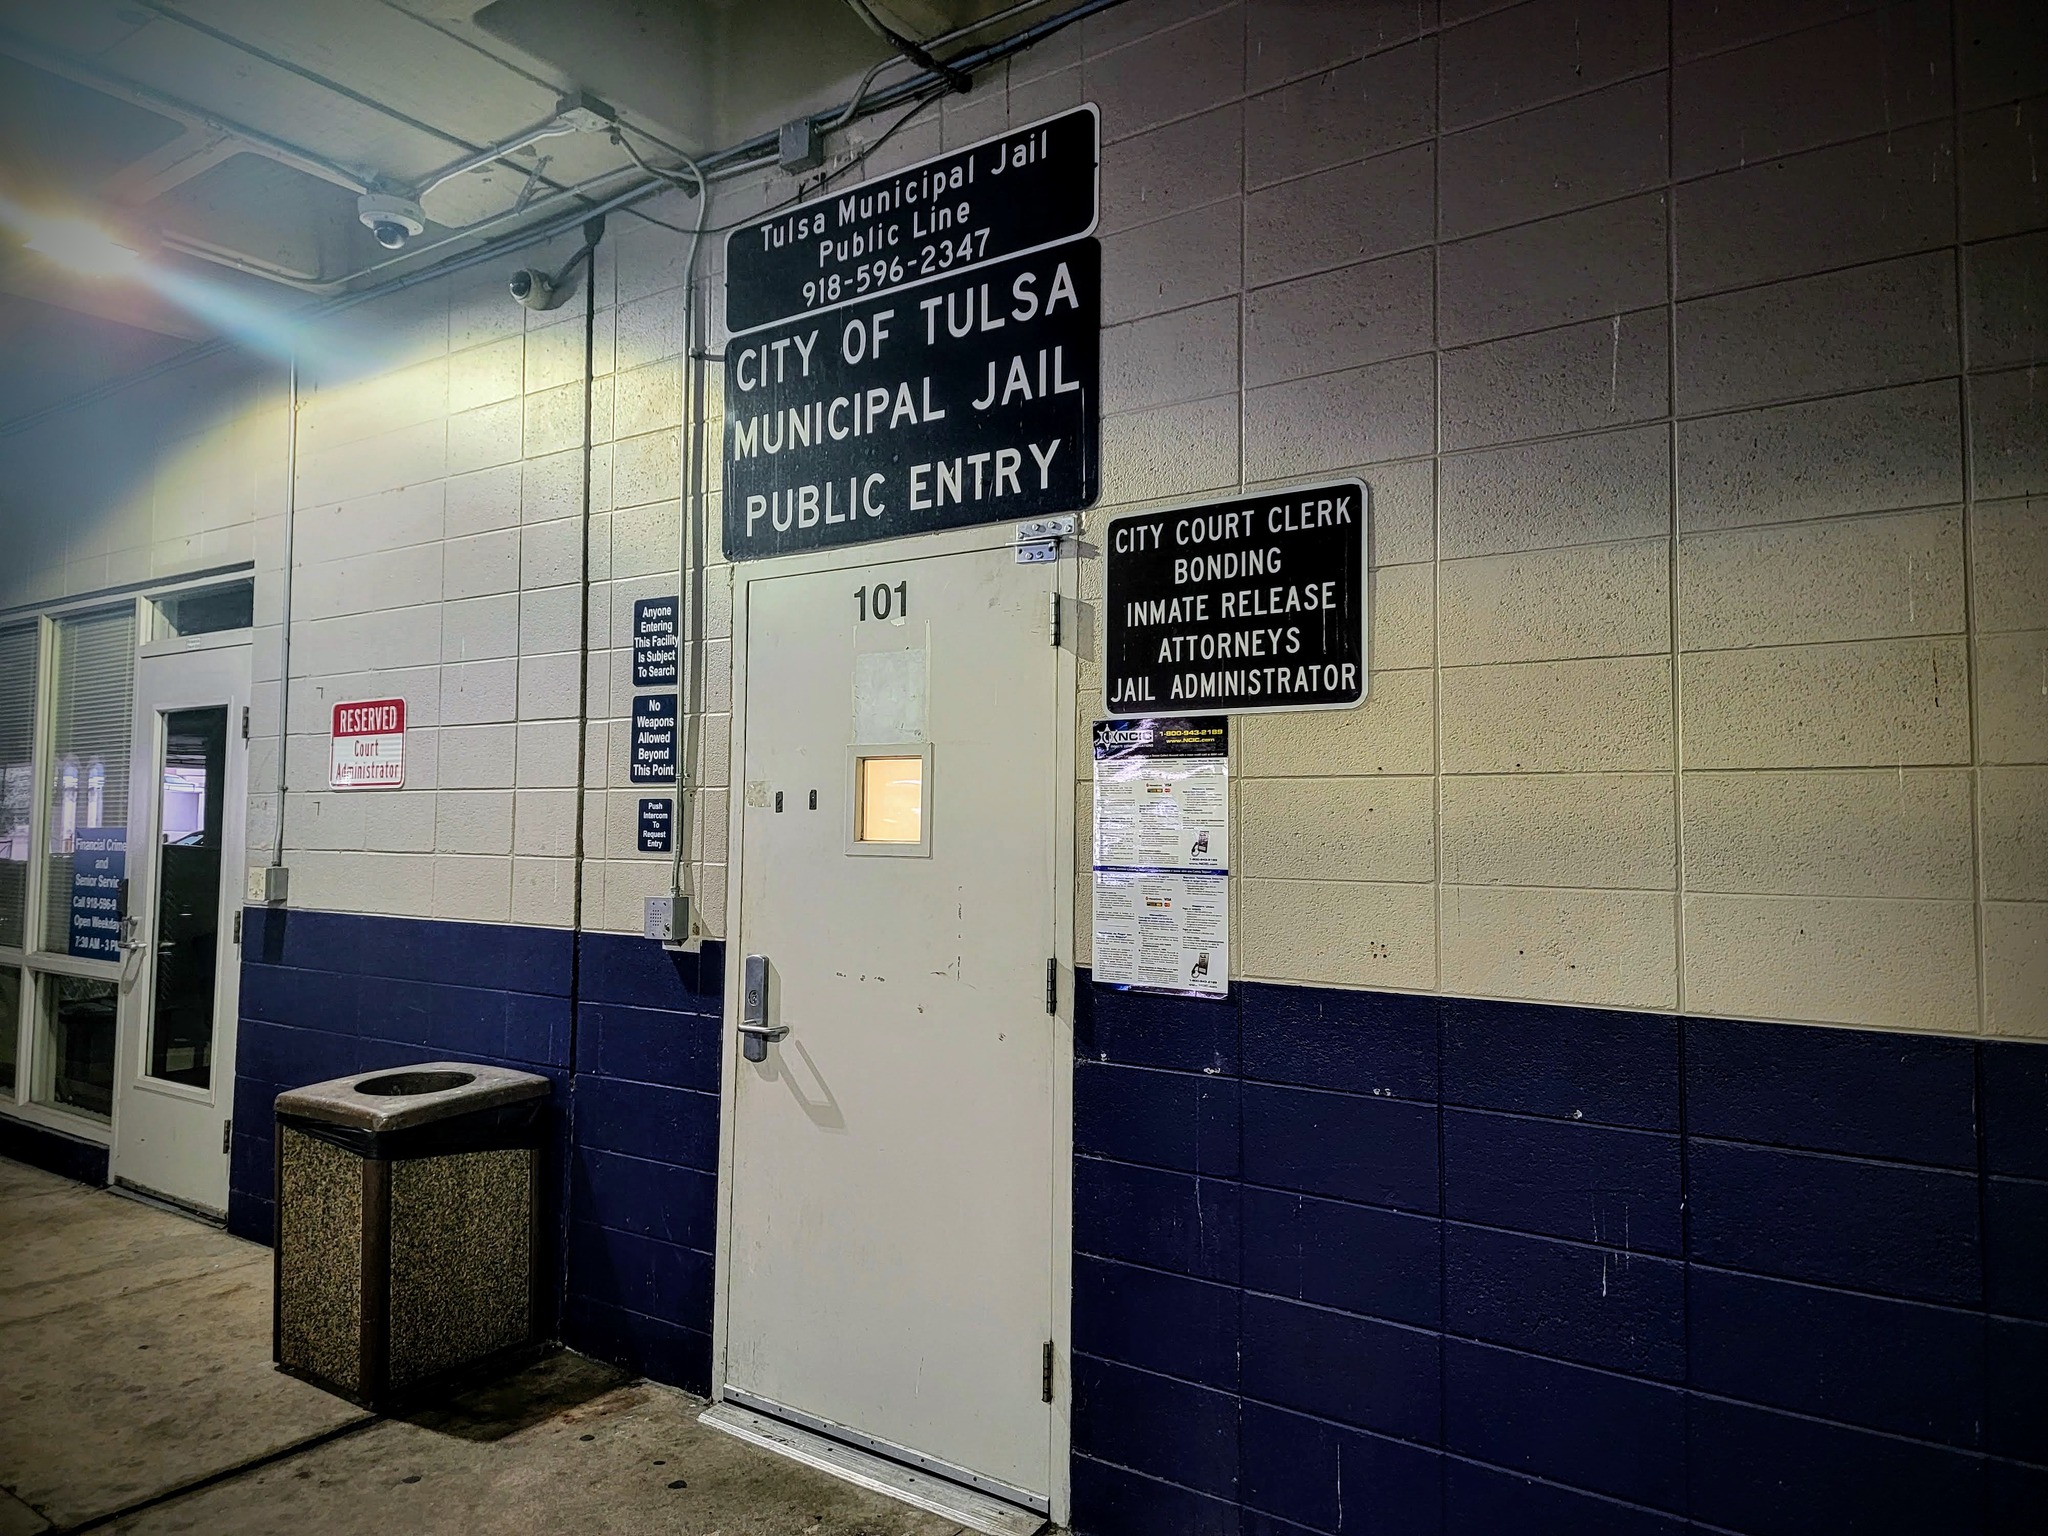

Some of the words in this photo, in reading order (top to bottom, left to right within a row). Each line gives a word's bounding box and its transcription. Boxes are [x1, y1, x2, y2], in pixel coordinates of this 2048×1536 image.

[761, 211, 826, 251] Tulsa
[839, 155, 974, 227] Municipal
[991, 130, 1047, 175] Jail
[820, 224, 899, 267] Public
[914, 202, 970, 238] Line
[803, 228, 991, 307] 918-596-2347
[737, 330, 818, 391] CITY
[842, 309, 895, 365] OF
[920, 262, 1079, 345] TULSA
[734, 376, 945, 461] MUNICIPAL
[972, 346, 1080, 410] JAIL
[746, 472, 886, 537] PUBLIC
[910, 439, 1061, 511] ENTRY
[1116, 523, 1164, 553] CITY
[1176, 510, 1254, 545] COURT
[1268, 496, 1351, 533] CLERK
[1174, 547, 1281, 584] BONDING
[854, 581, 907, 621] 101
[1127, 595, 1209, 627] INMATE
[1222, 581, 1336, 619] RELEASE
[642, 606, 672, 619] Anyone
[641, 620, 673, 633] Entering
[634, 636, 651, 648] This
[652, 634, 679, 648] Facility
[1158, 627, 1300, 663] ATTORNEYS
[638, 652, 645, 663] Is
[647, 649, 675, 664] Subject
[638, 667, 647, 677] To
[648, 665, 675, 677] Search
[1111, 676, 1155, 703] JAIL
[1170, 663, 1356, 700] ADMINISTRATOR
[649, 699, 661, 711] No
[340, 706, 397, 733] RESERVED
[637, 716, 674, 730] Weapons
[638, 731, 671, 744] Allowed
[1118, 731, 1152, 741] NCIC
[354, 739, 379, 757] Court
[638, 747, 669, 763] Beyond
[336, 761, 399, 779] Administrator
[633, 764, 651, 776] This
[652, 763, 674, 776] Point
[648, 802, 663, 810] Push
[643, 811, 668, 819] Intercom
[643, 830, 666, 839] Request
[76, 838, 106, 851] Financial
[647, 840, 663, 849] Entry
[95, 857, 109, 869] and
[75, 873, 97, 886] Senior
[73, 895, 86, 908] Call
[74, 914, 91, 929] Open
[75, 936, 89, 948] 7:30
[89, 937, 100, 949] AM
[105, 939, 110, 951] 3
